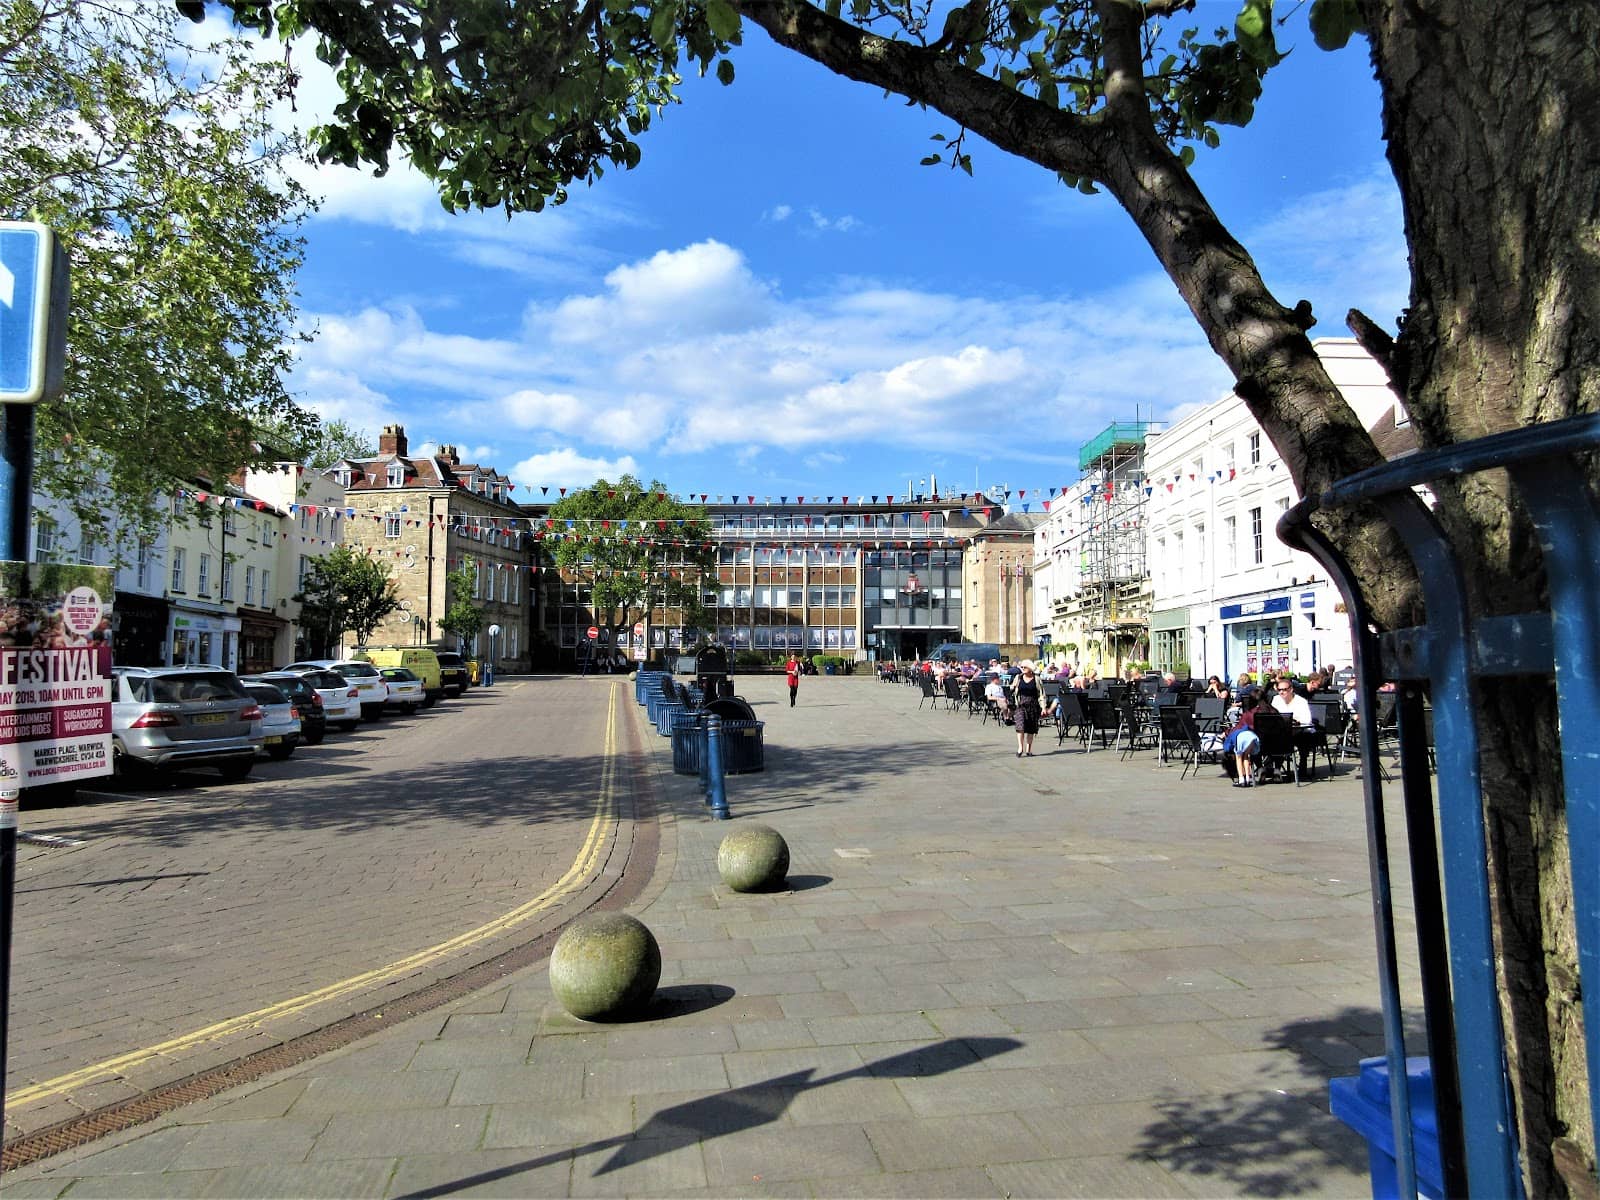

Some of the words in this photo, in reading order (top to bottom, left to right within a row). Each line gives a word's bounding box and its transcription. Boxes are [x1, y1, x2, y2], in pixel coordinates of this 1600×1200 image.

[2, 649, 104, 685] FESTIVAL
[15, 690, 37, 705] 2019,
[39, 688, 60, 702] 10AM
[62, 687, 85, 700] UNTIL
[87, 686, 104, 699] 6PM
[63, 708, 104, 720] SUGARCRAFT
[14, 725, 31, 737] KIDS
[31, 723, 52, 736] RIDES
[64, 719, 104, 732] WORKSHOPS
[34, 747, 57, 758] MARKET
